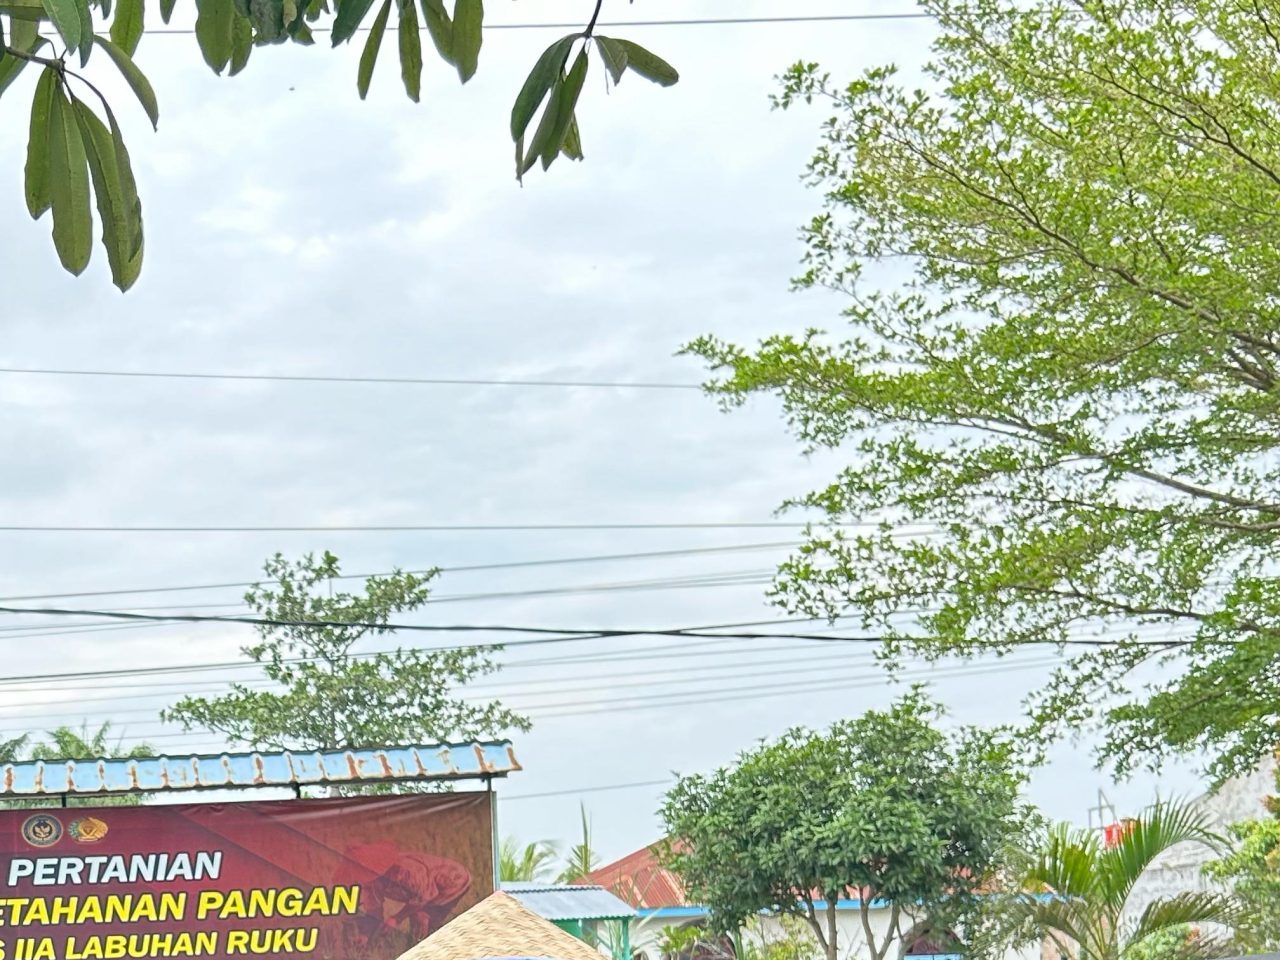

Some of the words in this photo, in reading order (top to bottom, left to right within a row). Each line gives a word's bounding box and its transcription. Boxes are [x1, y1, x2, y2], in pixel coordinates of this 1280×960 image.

[7, 852, 222, 886] PERTANIAN
[196, 885, 360, 920] PANGAN
[14, 937, 57, 960] IIA
[64, 931, 218, 960] LABUHAN
[225, 927, 319, 955] RUKU
